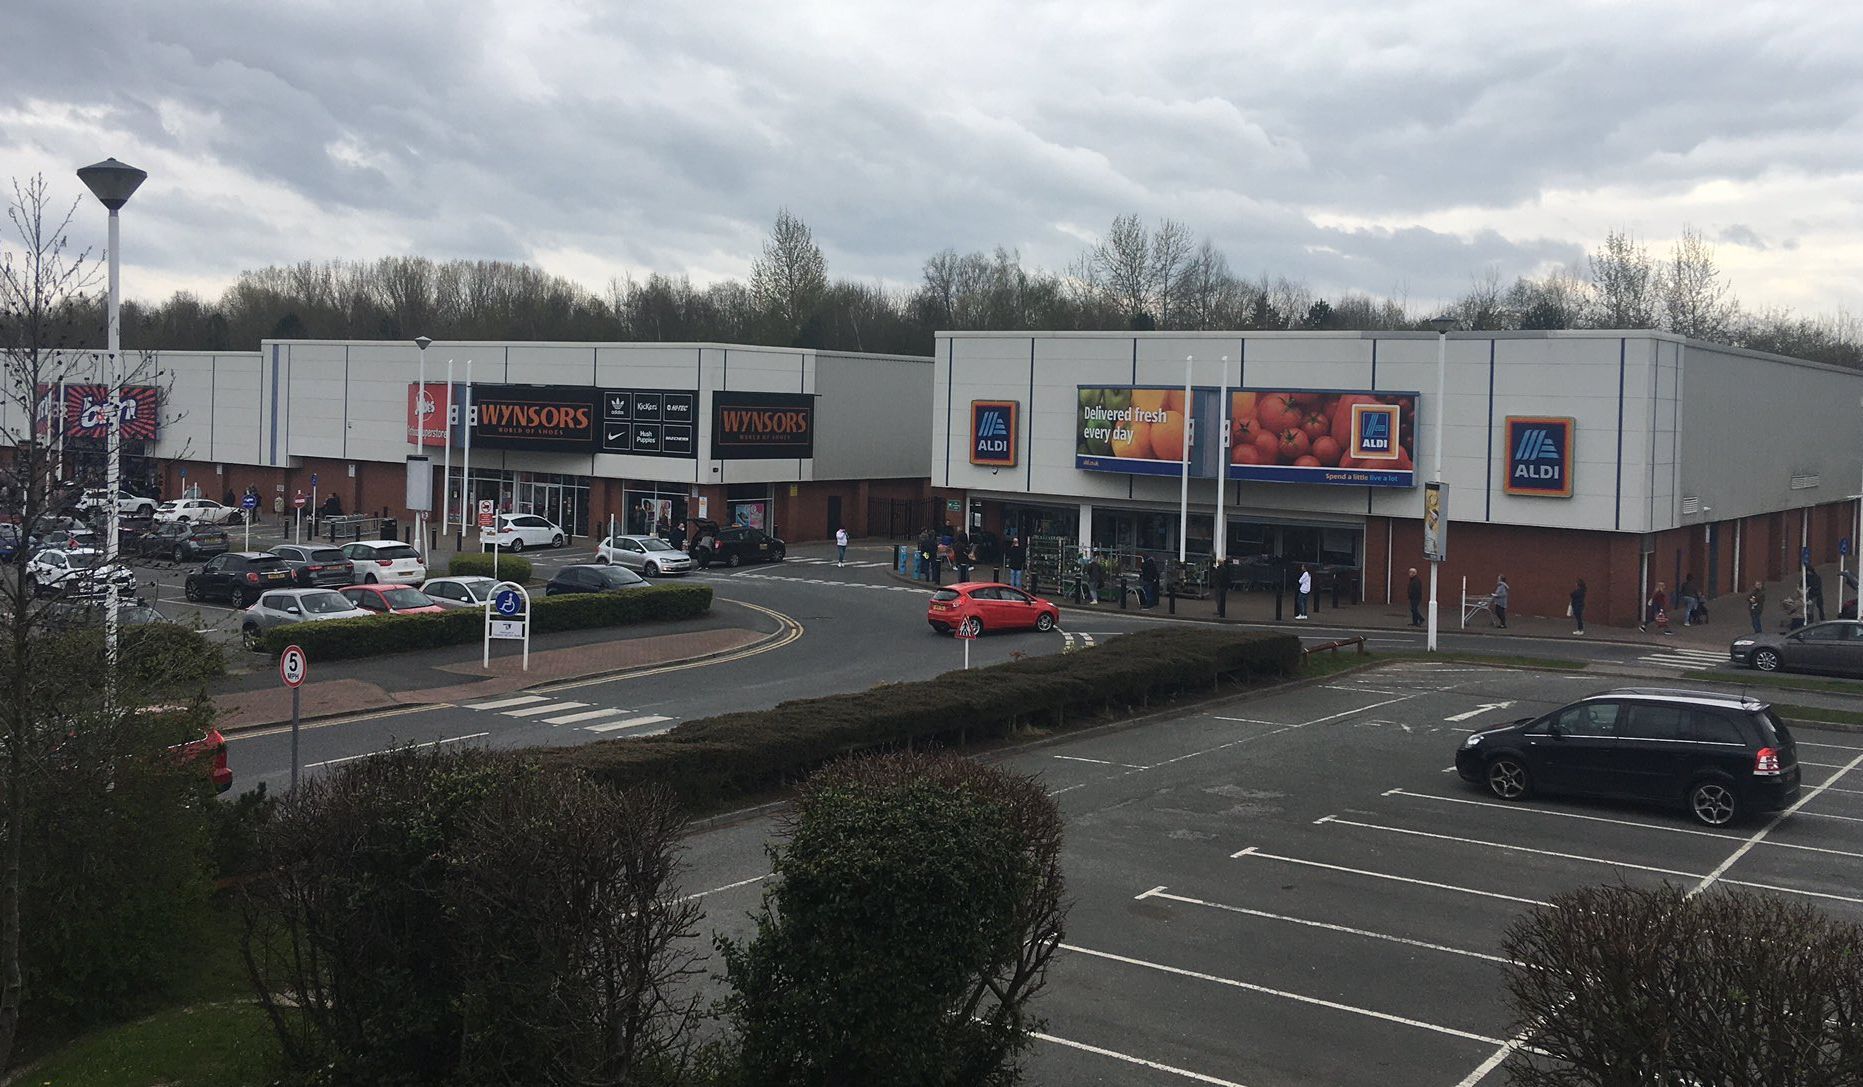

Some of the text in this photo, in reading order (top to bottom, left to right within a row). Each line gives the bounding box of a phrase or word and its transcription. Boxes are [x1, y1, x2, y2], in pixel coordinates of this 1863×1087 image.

[481, 404, 589, 429] WYNSORS
[722, 411, 807, 433] WYNSORS
[1084, 405, 1167, 424] Delivered fresh
[1083, 427, 1134, 444] every day
[1362, 438, 1388, 448] ALDI
[977, 439, 1008, 452] ALDI
[1514, 464, 1560, 480] ALDI
[289, 652, 298, 672] 5
[287, 672, 300, 680] MPH
